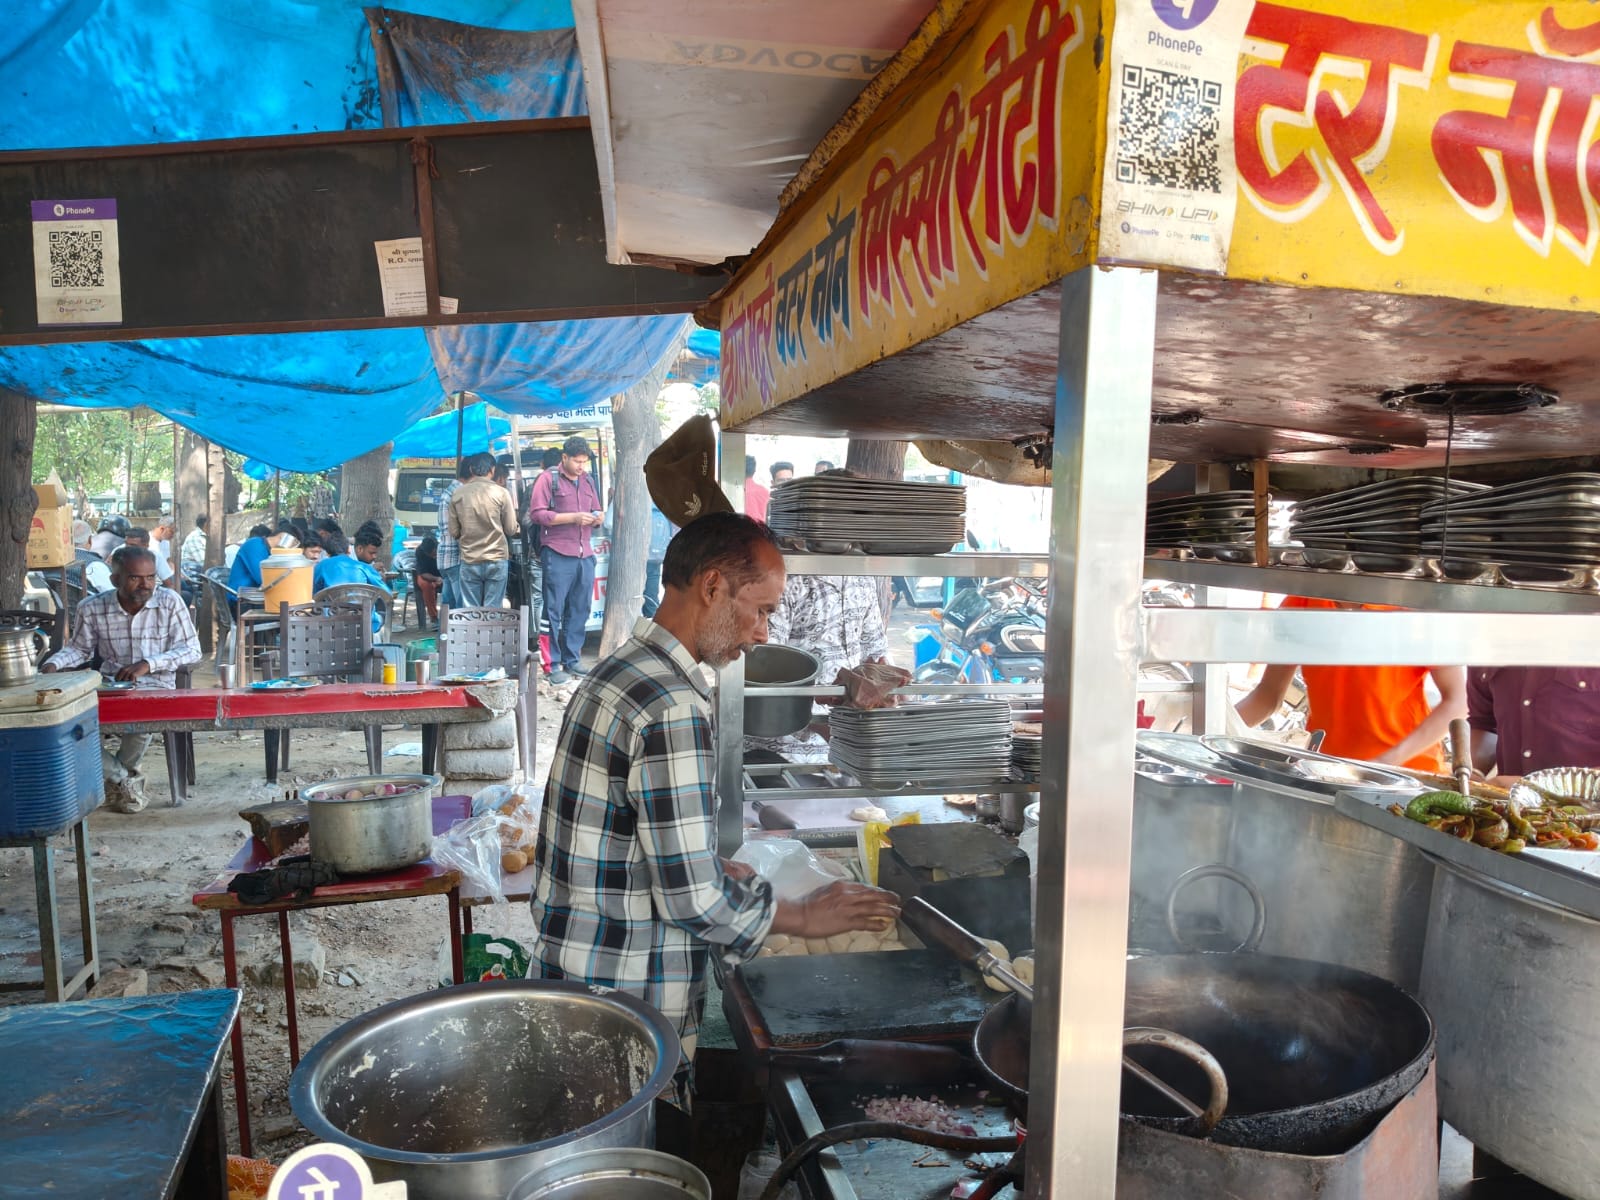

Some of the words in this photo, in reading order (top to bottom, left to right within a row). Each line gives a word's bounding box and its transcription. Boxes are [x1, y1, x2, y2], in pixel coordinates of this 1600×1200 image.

[1148, 31, 1202, 55] PhonePe
[1234, 2, 1434, 248] टर
[776, 247, 813, 370] बटर
[955, 0, 1078, 278] रोटी
[66, 207, 95, 215] PhonePe
[1116, 200, 1168, 217] BHIM
[1181, 207, 1213, 221] UPI
